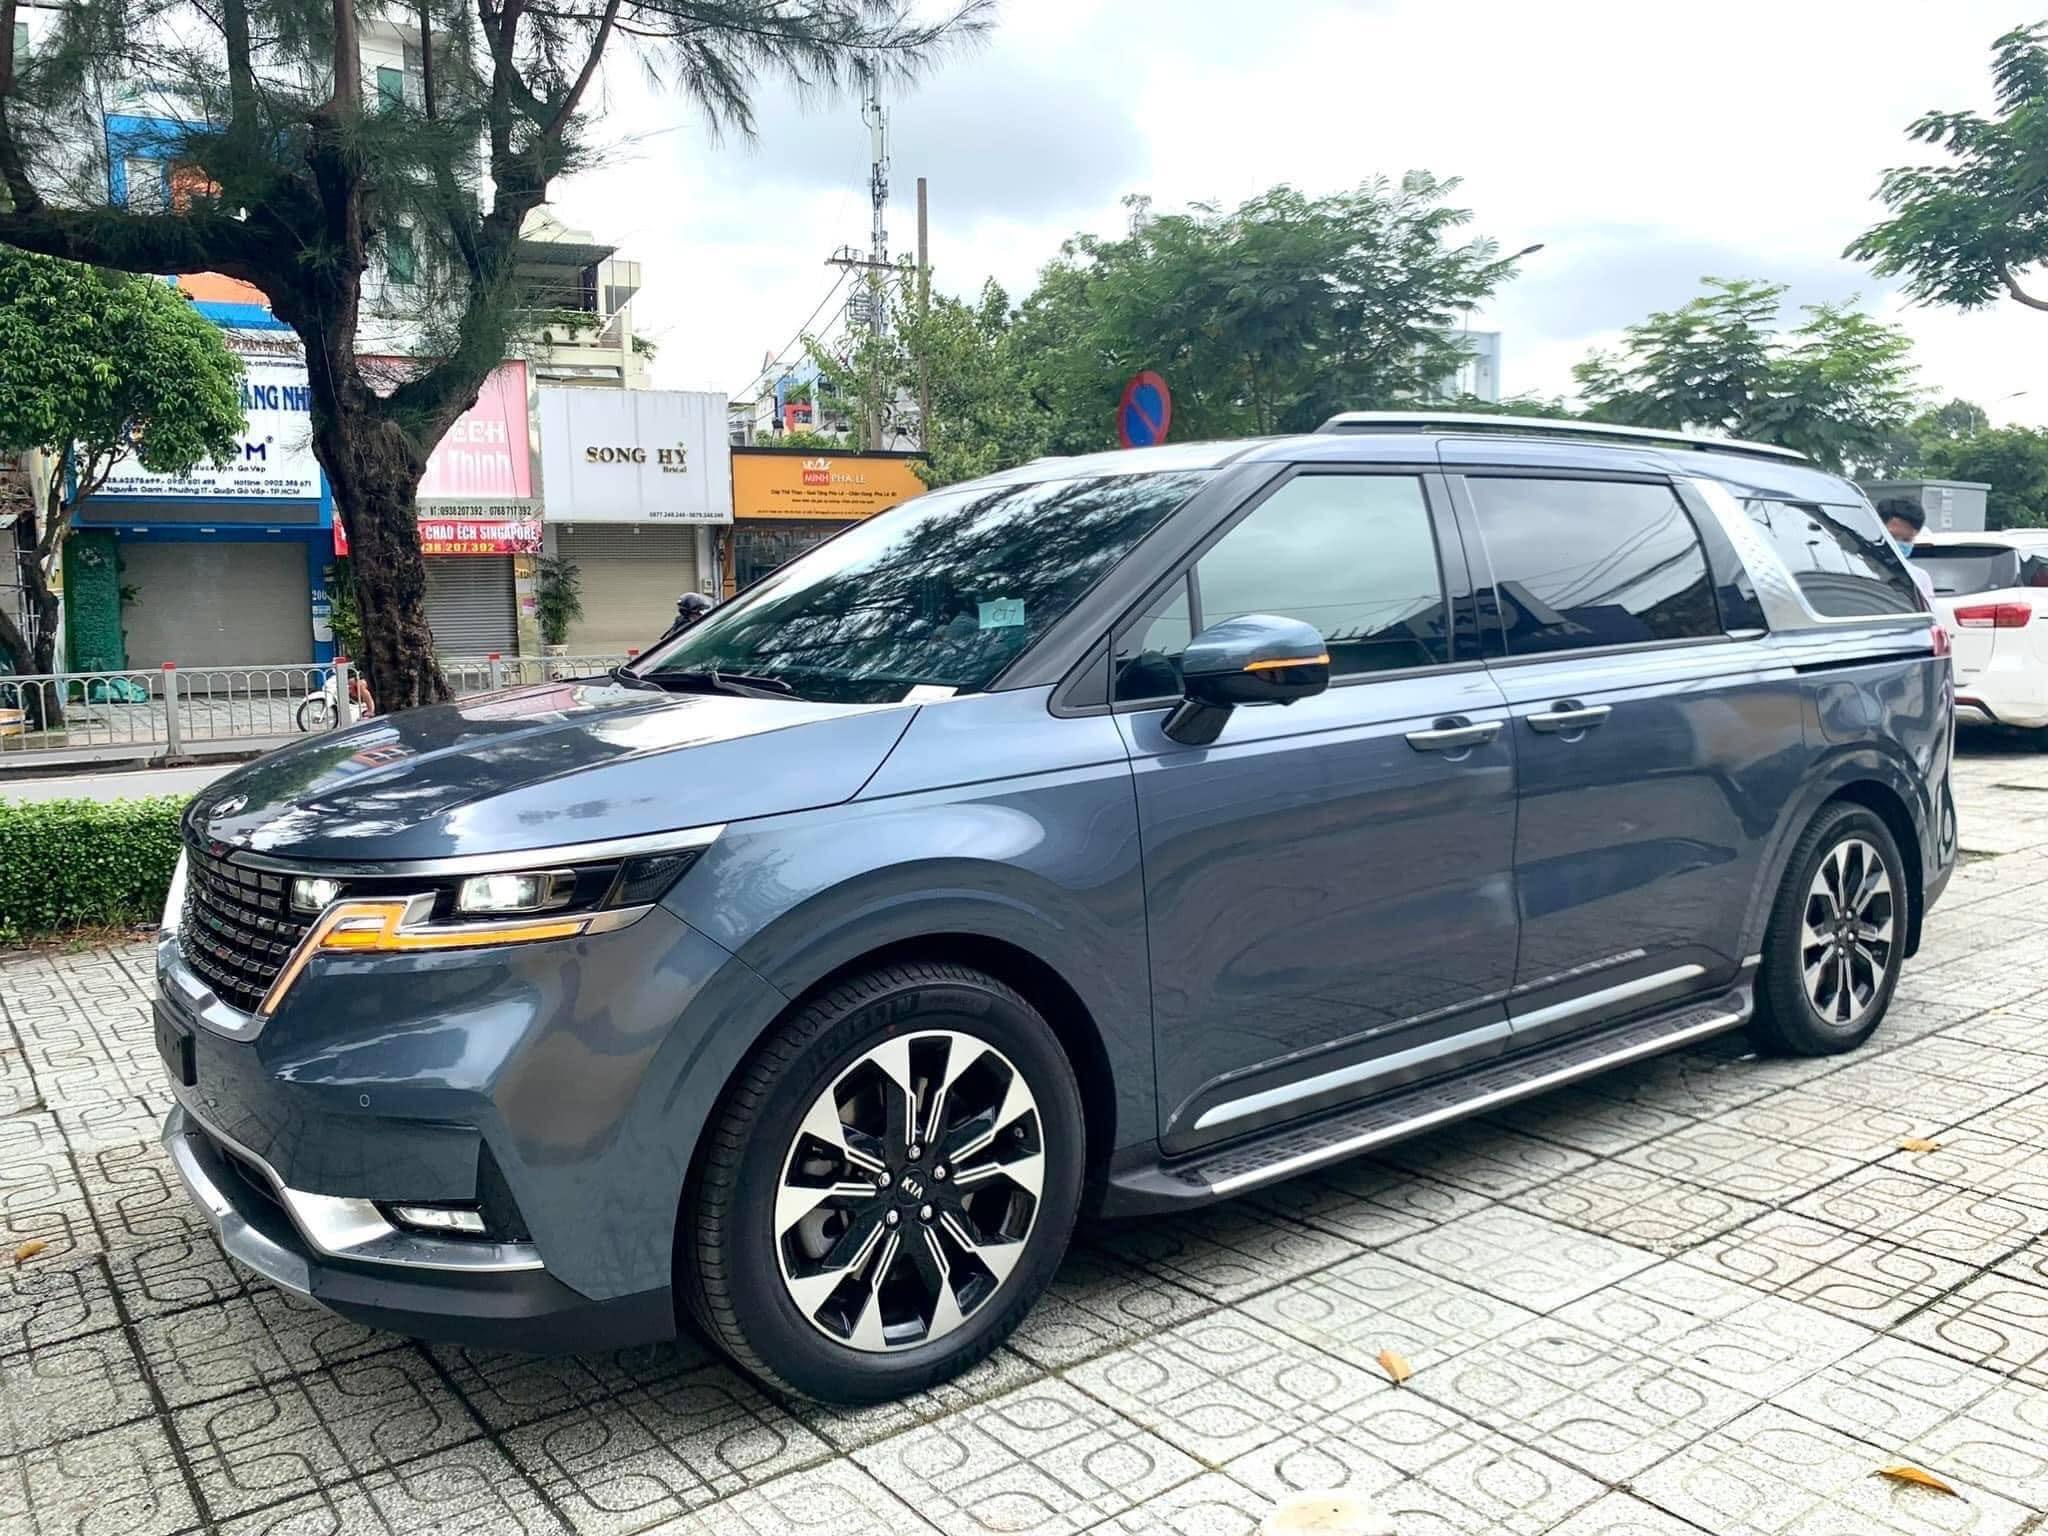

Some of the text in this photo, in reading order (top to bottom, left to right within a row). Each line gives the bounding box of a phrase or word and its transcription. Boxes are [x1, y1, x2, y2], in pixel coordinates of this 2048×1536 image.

[586, 446, 647, 464] SONG
[804, 472, 829, 482] MINH
[831, 473, 853, 483] PHA
[480, 525, 536, 541] SINGAPORE
[901, 1176, 923, 1200] KIA
